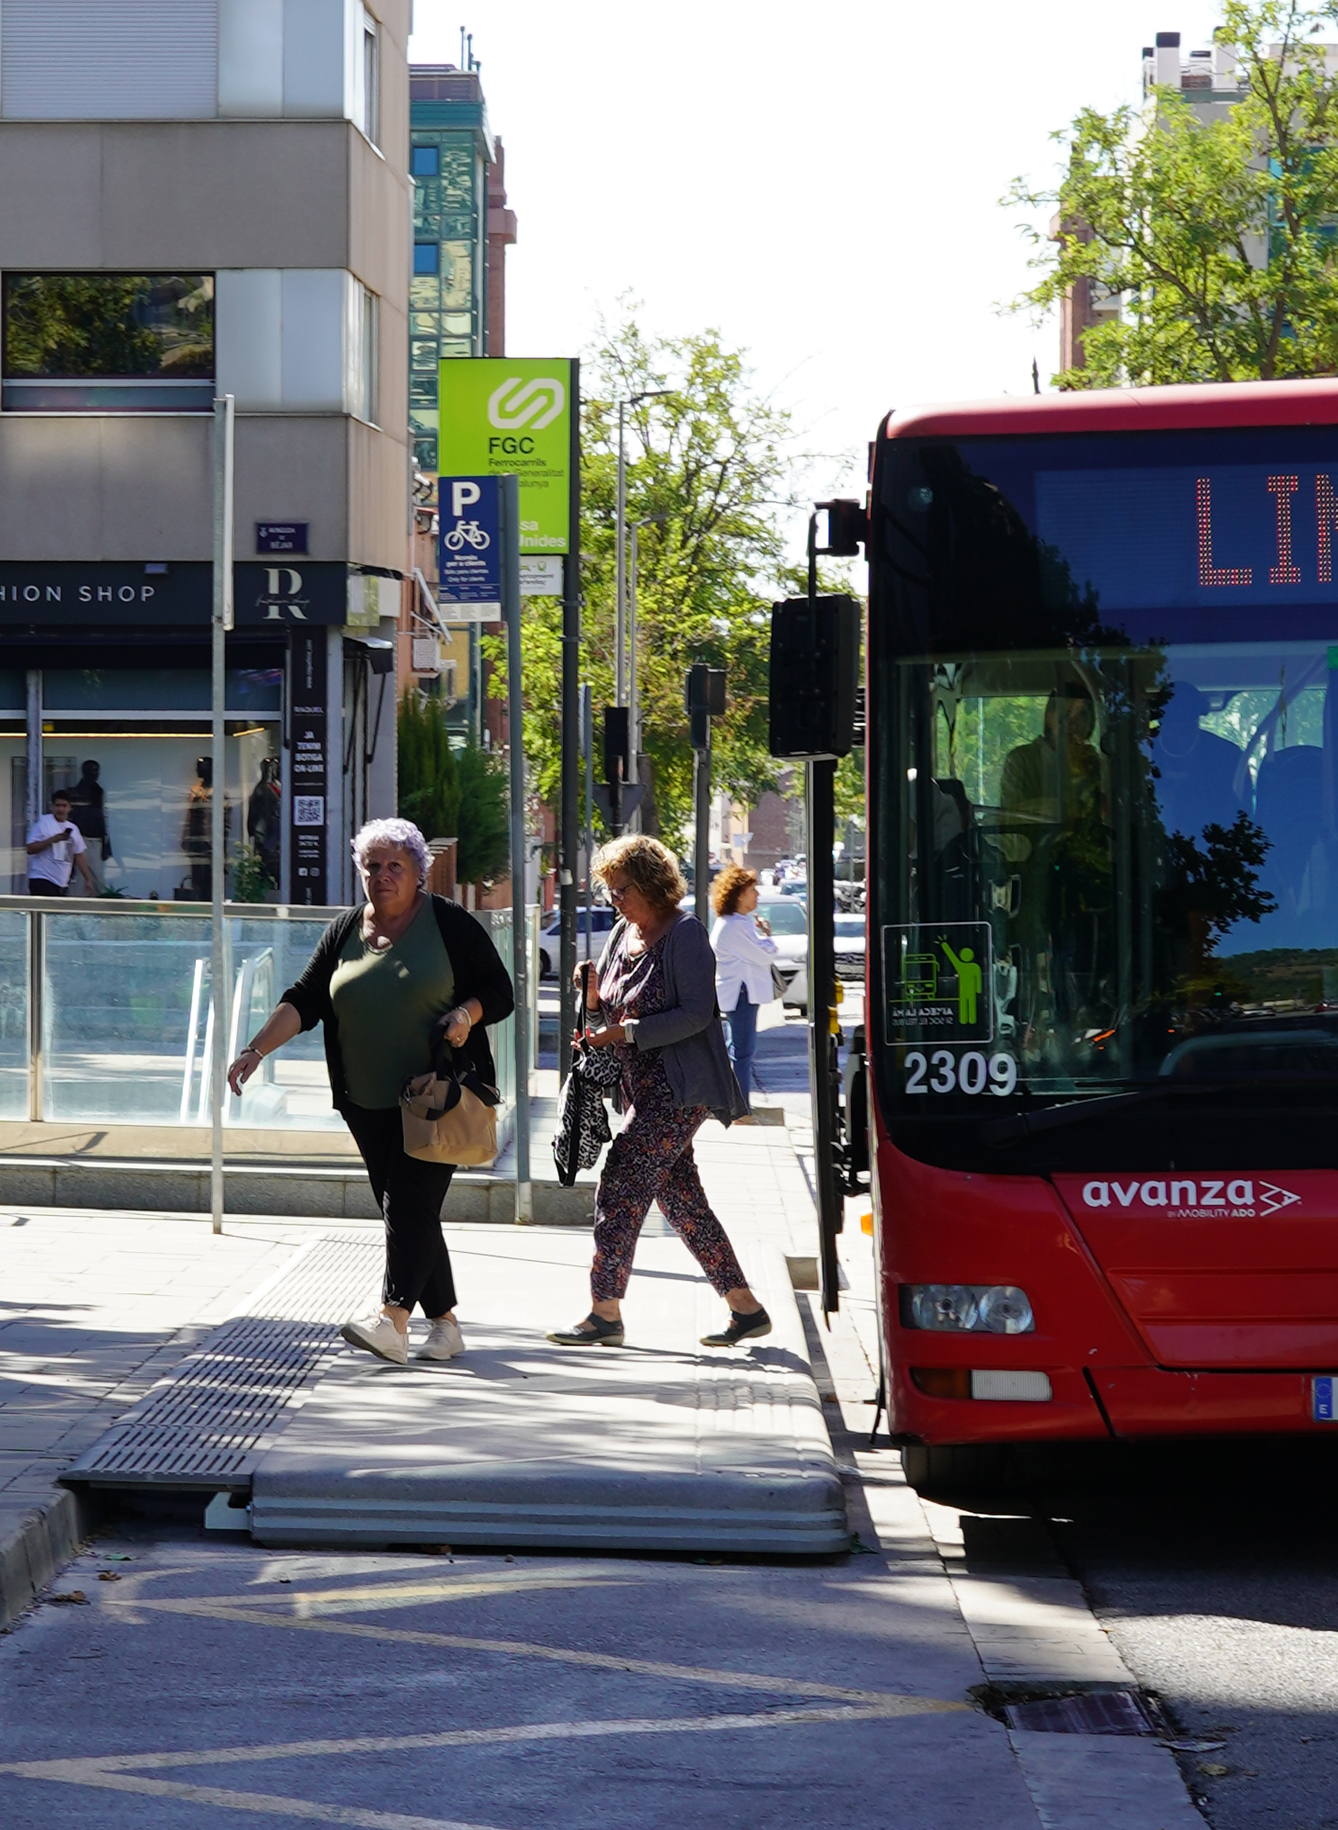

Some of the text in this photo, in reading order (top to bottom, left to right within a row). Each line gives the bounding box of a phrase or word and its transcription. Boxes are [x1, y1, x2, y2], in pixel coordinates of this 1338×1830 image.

[489, 436, 535, 454] FGC
[488, 458, 547, 467] Ferrocarrils
[514, 468, 565, 477] Generalitat
[518, 480, 550, 489] alunya
[452, 481, 481, 517] P
[78, 585, 155, 602] SHOP
[262, 567, 309, 620] R
[294, 753, 324, 761] BOTIGA
[904, 1050, 1017, 1096] 2309
[1082, 1179, 1256, 1208] avanza
[1177, 1208, 1230, 1218] MOBILITY
[1230, 1208, 1256, 1217] ADO
[1318, 1403, 1329, 1415] E
